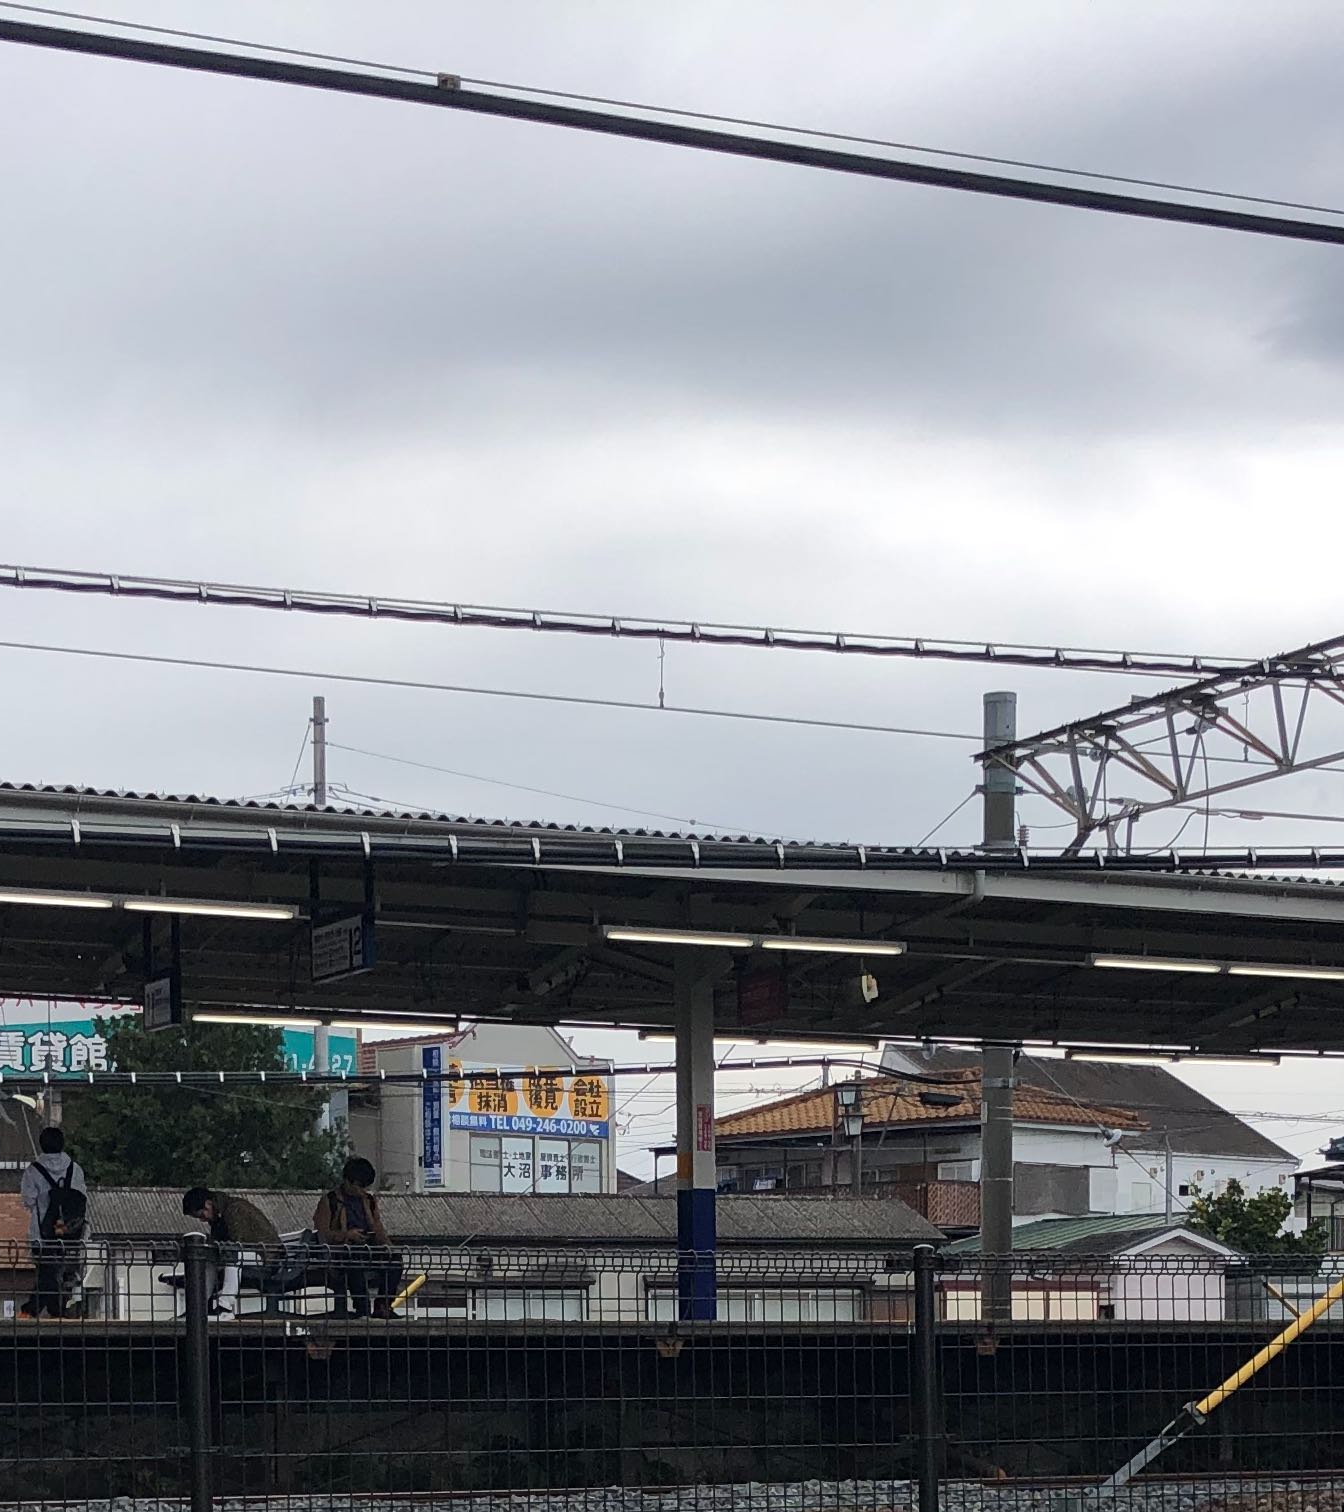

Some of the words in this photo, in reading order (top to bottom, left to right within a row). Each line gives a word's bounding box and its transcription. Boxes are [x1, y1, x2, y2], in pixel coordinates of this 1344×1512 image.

[573, 1078, 602, 1098] 会社
[477, 1091, 508, 1113] 抹消
[573, 1098, 602, 1118] 設立
[489, 1114, 510, 1130] TEL
[511, 1117, 587, 1135] 049-246-0200
[503, 1161, 585, 1181] 大沼事務所
